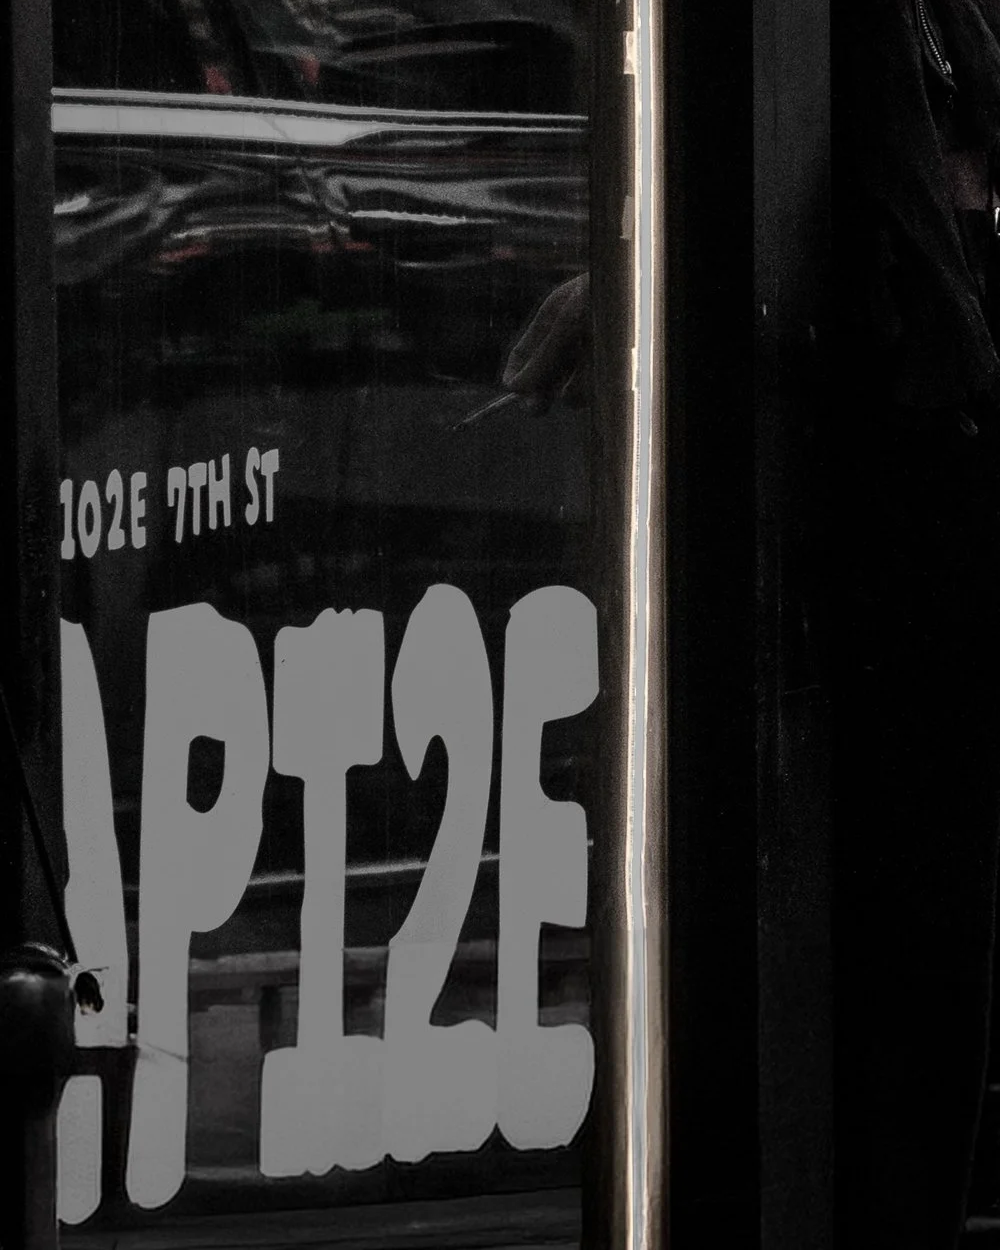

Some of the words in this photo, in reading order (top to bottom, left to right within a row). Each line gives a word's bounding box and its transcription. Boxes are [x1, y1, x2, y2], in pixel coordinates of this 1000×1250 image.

[59, 468, 147, 560] 102E
[167, 453, 232, 543] 7TH
[245, 446, 280, 526] ST
